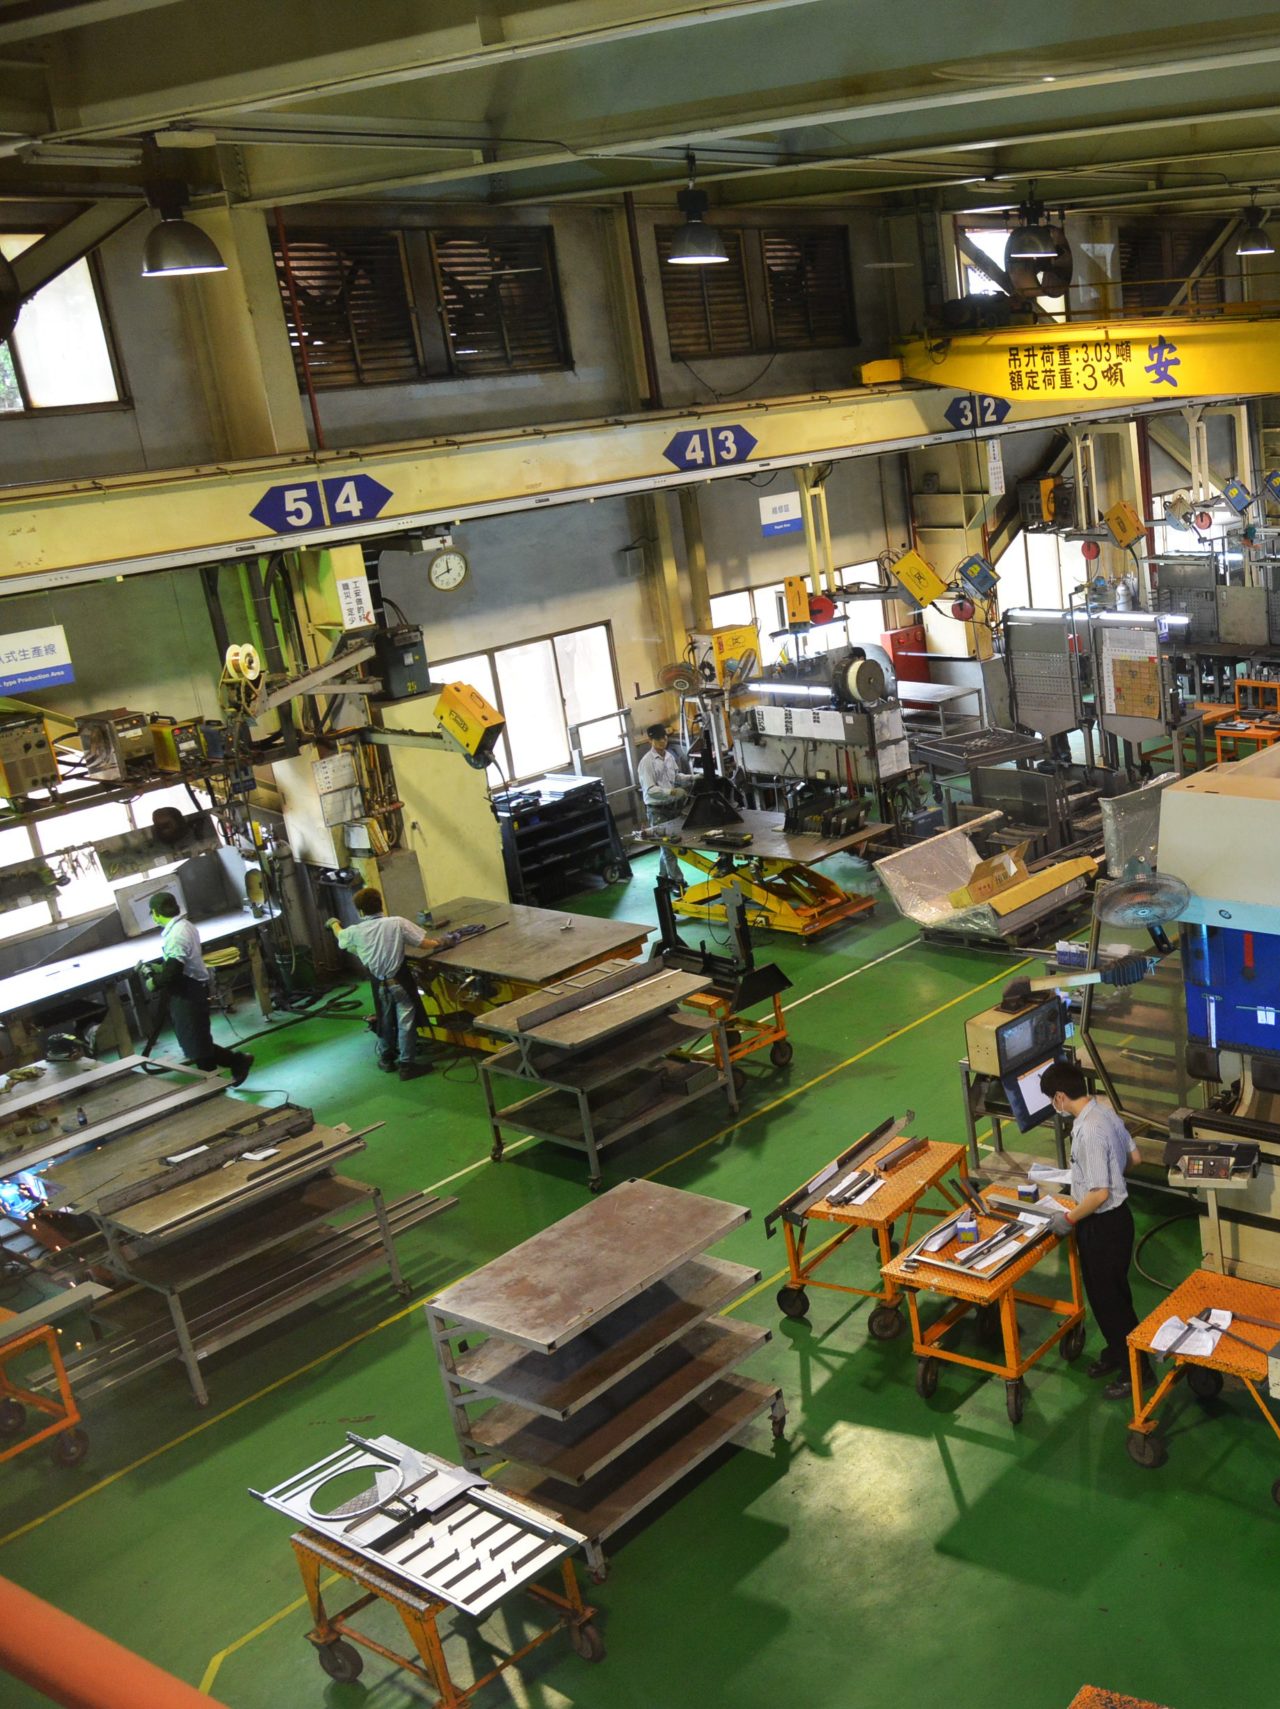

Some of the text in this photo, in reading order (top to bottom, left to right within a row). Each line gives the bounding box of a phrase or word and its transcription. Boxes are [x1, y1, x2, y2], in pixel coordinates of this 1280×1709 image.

[1144, 334, 1181, 388] 安
[959, 397, 998, 426] 3 2
[685, 430, 738, 464] 4 3
[284, 480, 364, 527] 5 4
